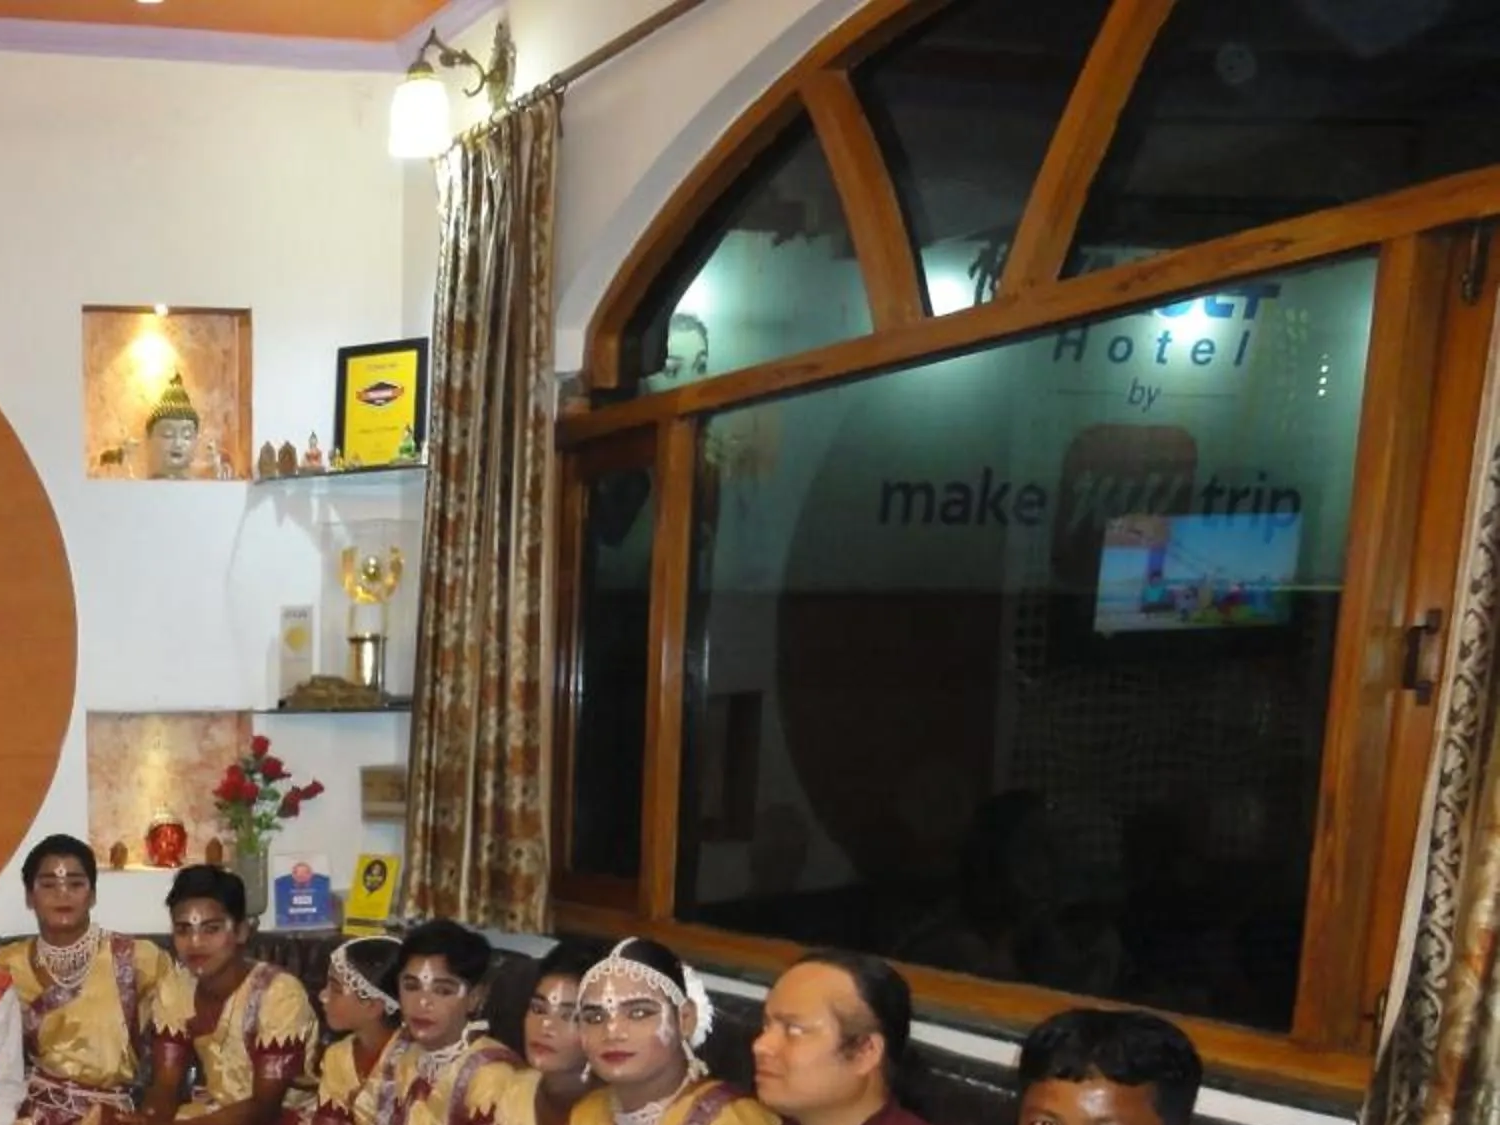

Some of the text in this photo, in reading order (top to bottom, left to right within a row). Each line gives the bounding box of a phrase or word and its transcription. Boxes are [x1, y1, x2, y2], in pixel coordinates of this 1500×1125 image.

[1051, 324, 1251, 368] Hotel
[1126, 377, 1163, 412] by
[878, 466, 1049, 527] make
[1200, 471, 1302, 544] trip
